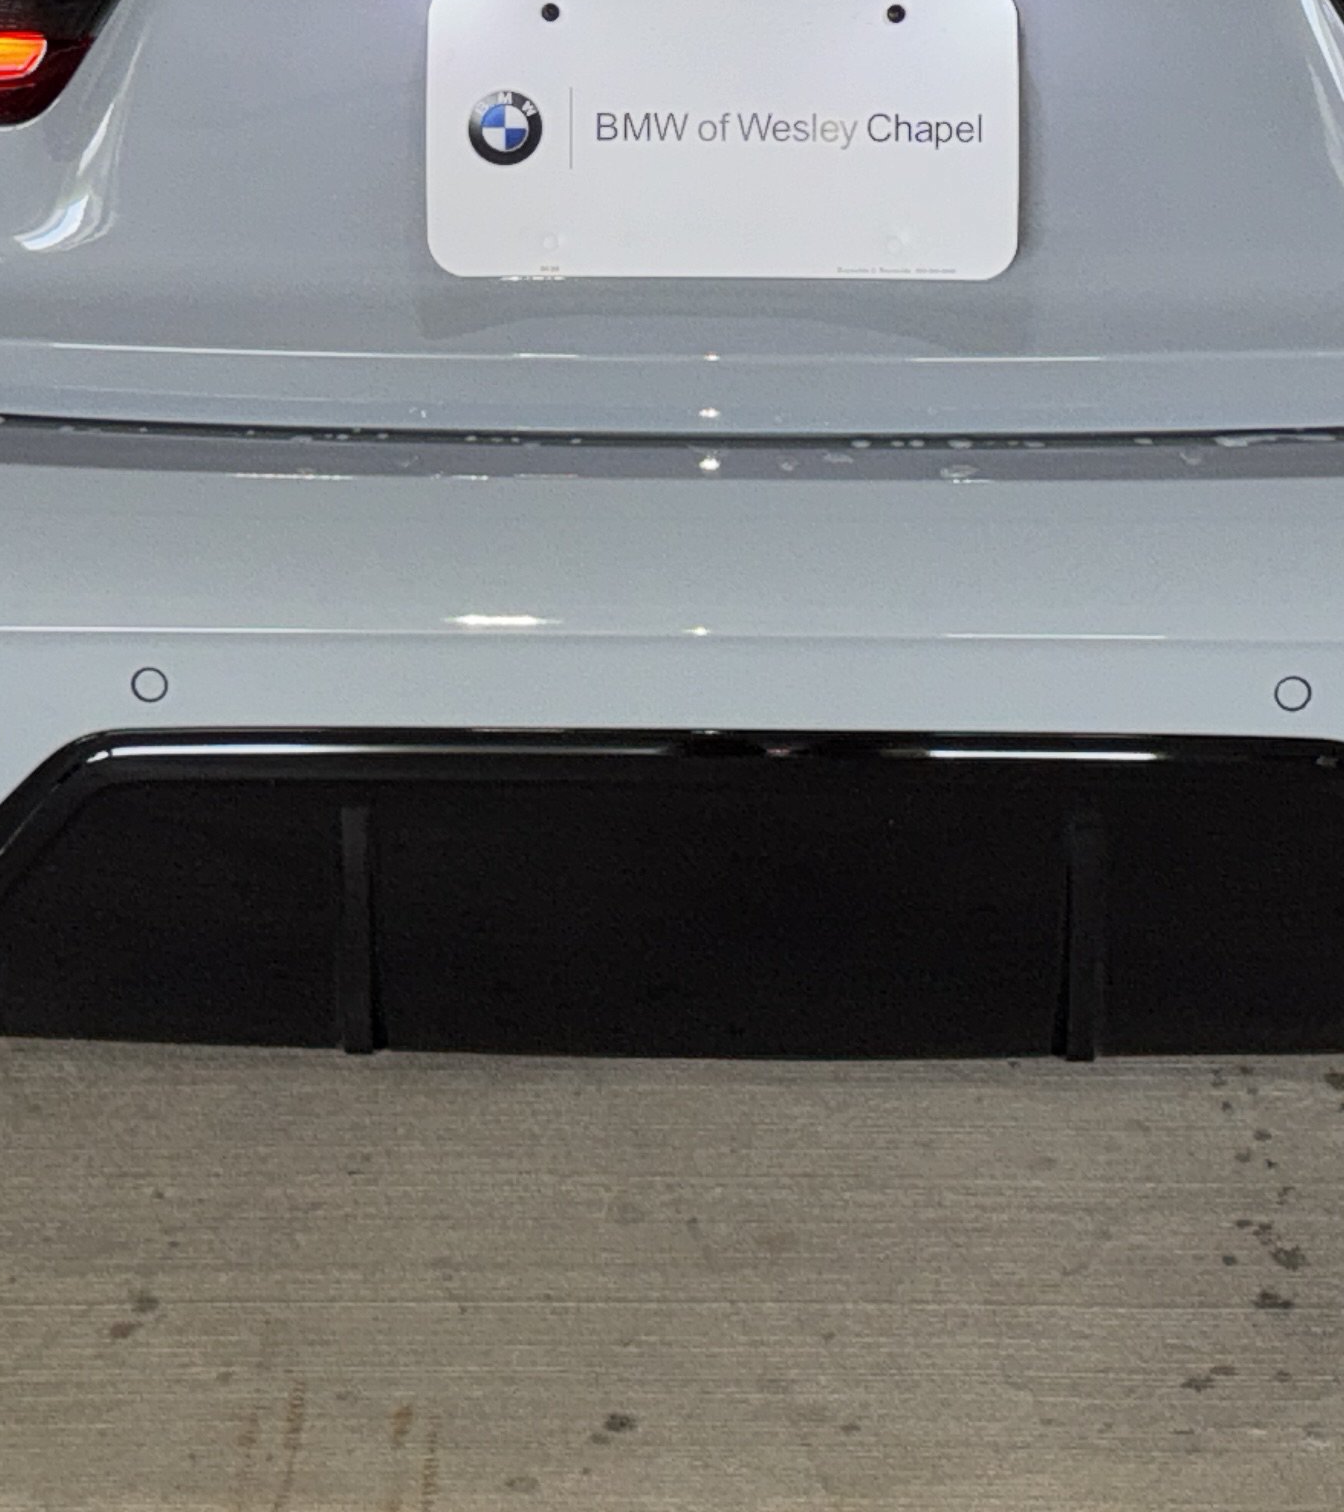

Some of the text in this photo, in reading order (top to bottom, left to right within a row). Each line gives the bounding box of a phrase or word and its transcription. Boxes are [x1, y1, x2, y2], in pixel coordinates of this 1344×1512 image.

[596, 112, 983, 151] BMW of Wesley Chapel
